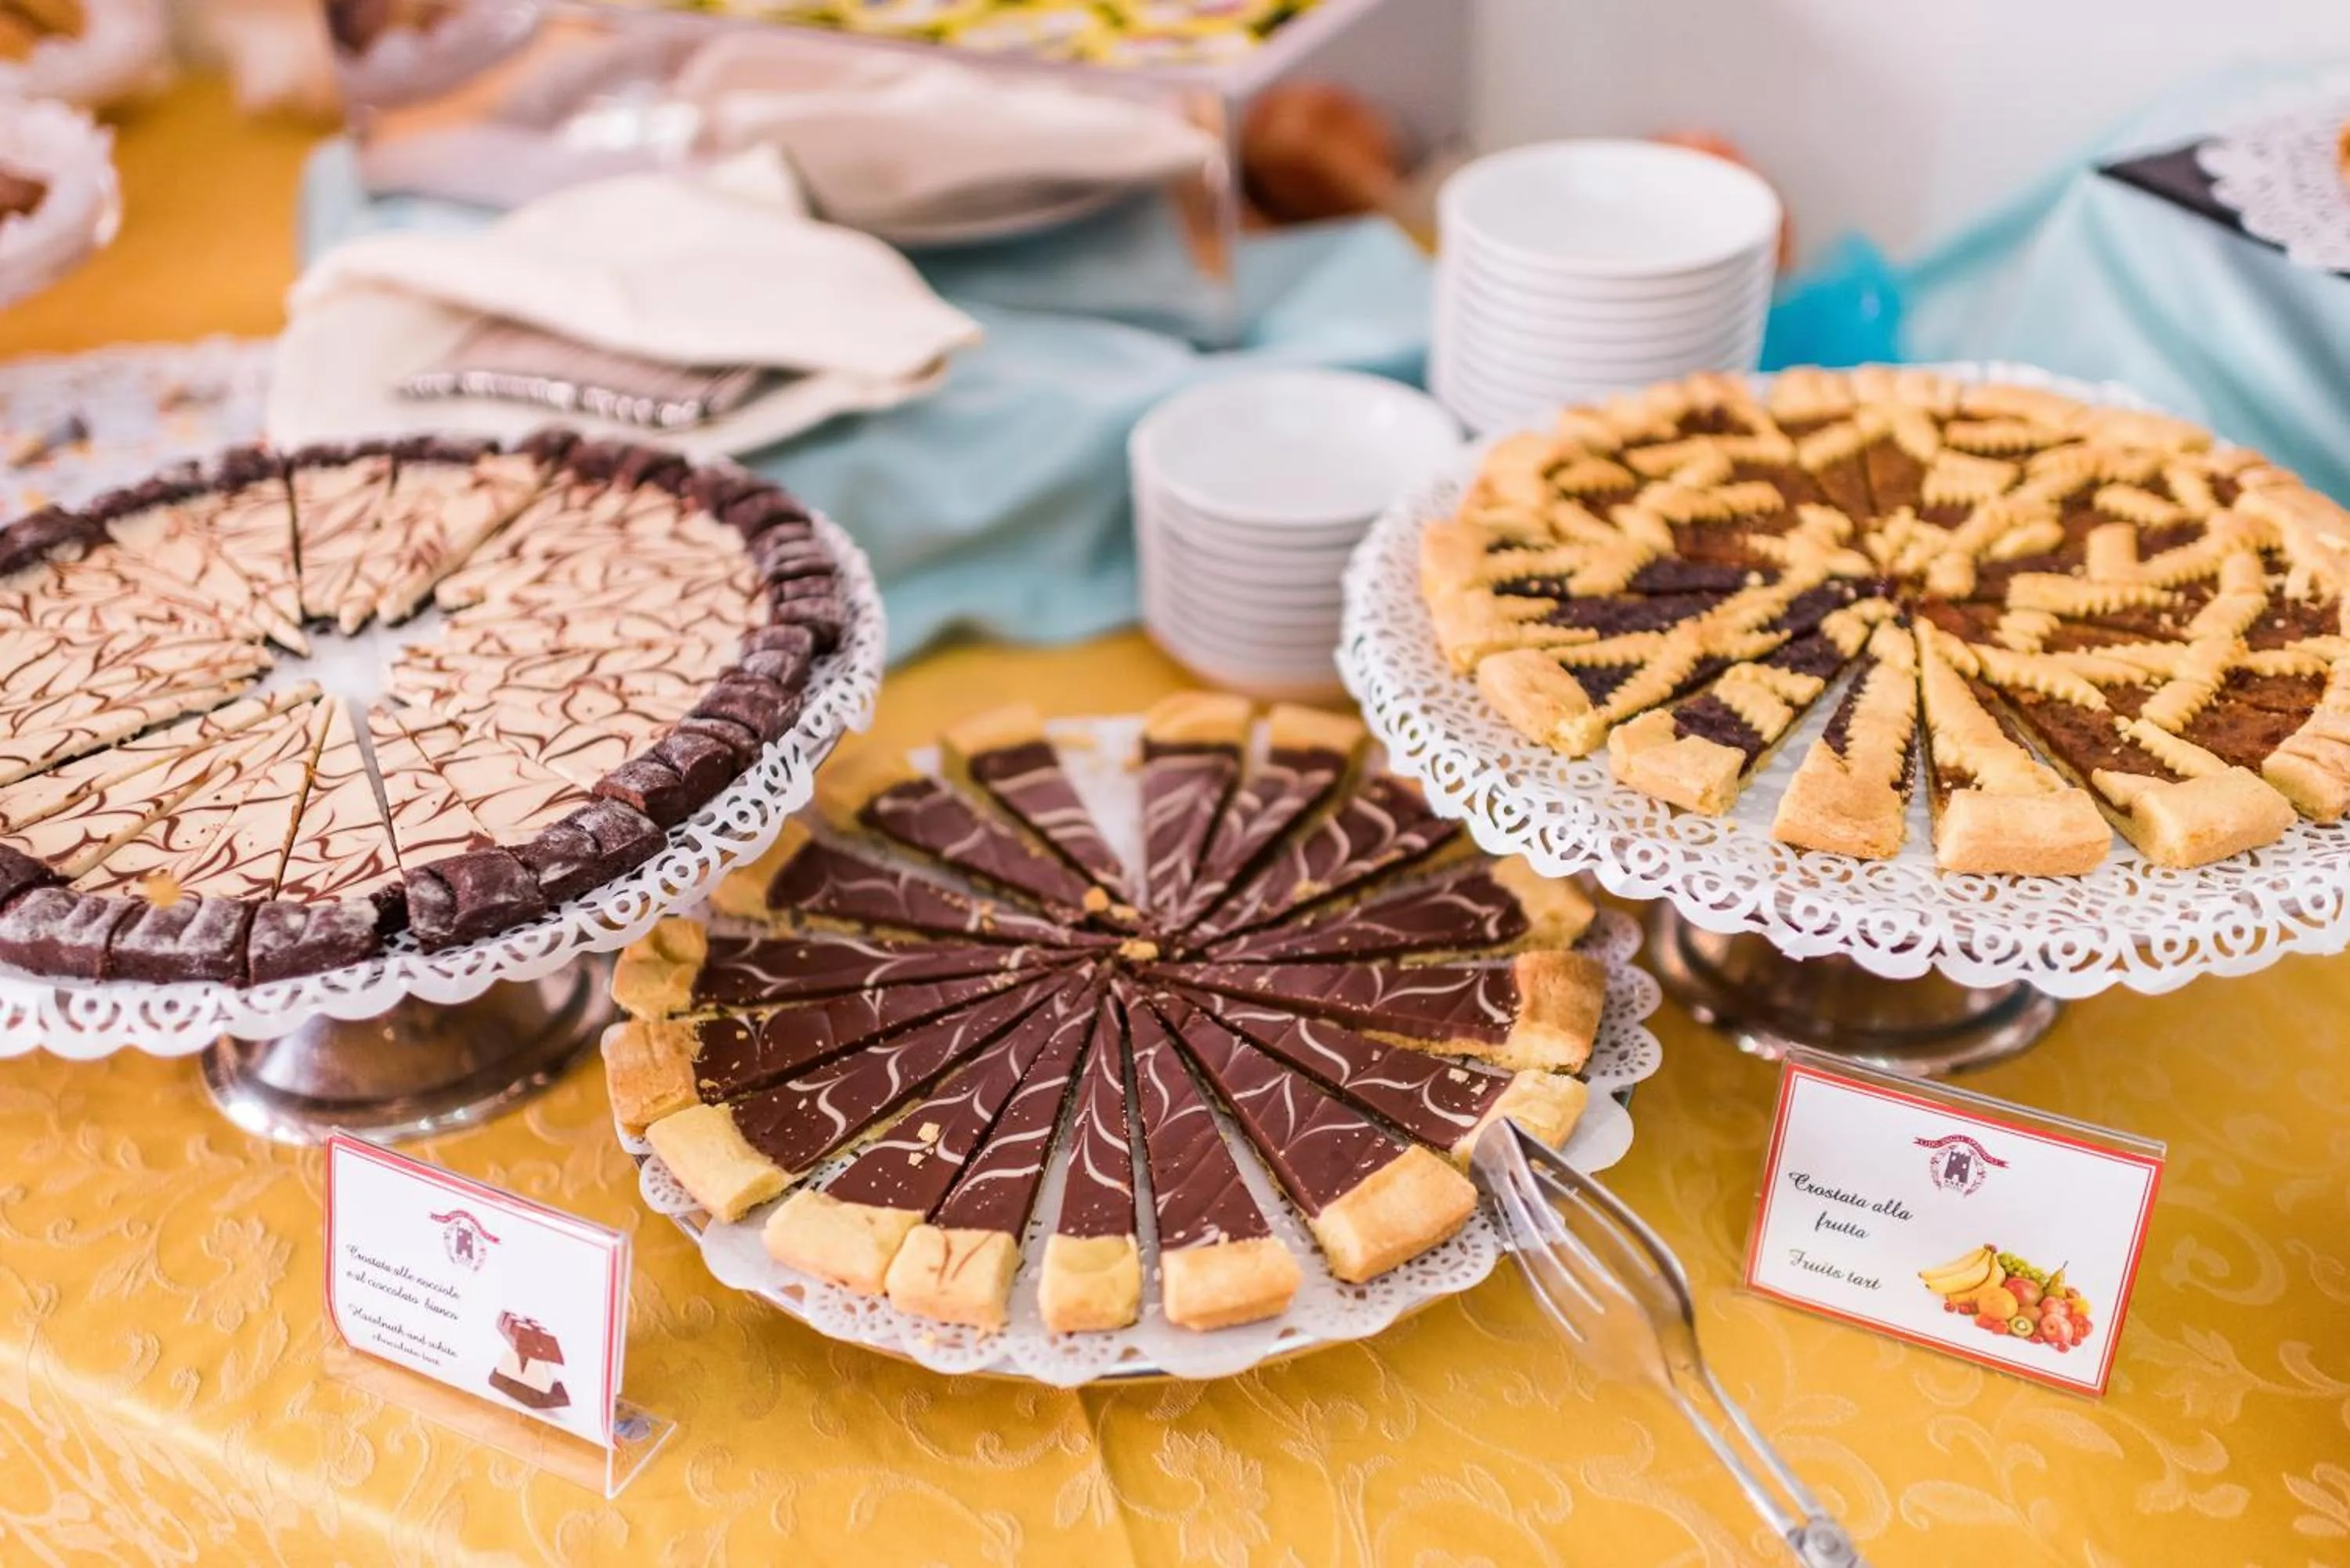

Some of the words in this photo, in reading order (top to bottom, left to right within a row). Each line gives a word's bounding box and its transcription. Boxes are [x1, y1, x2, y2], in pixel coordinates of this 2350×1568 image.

[1788, 1172, 1870, 1209] Crostata
[1871, 1198, 1914, 1221] alla
[1814, 1210, 1871, 1239] frutta
[1789, 1248, 1845, 1280] Fruits
[1846, 1271, 1882, 1291] tart
